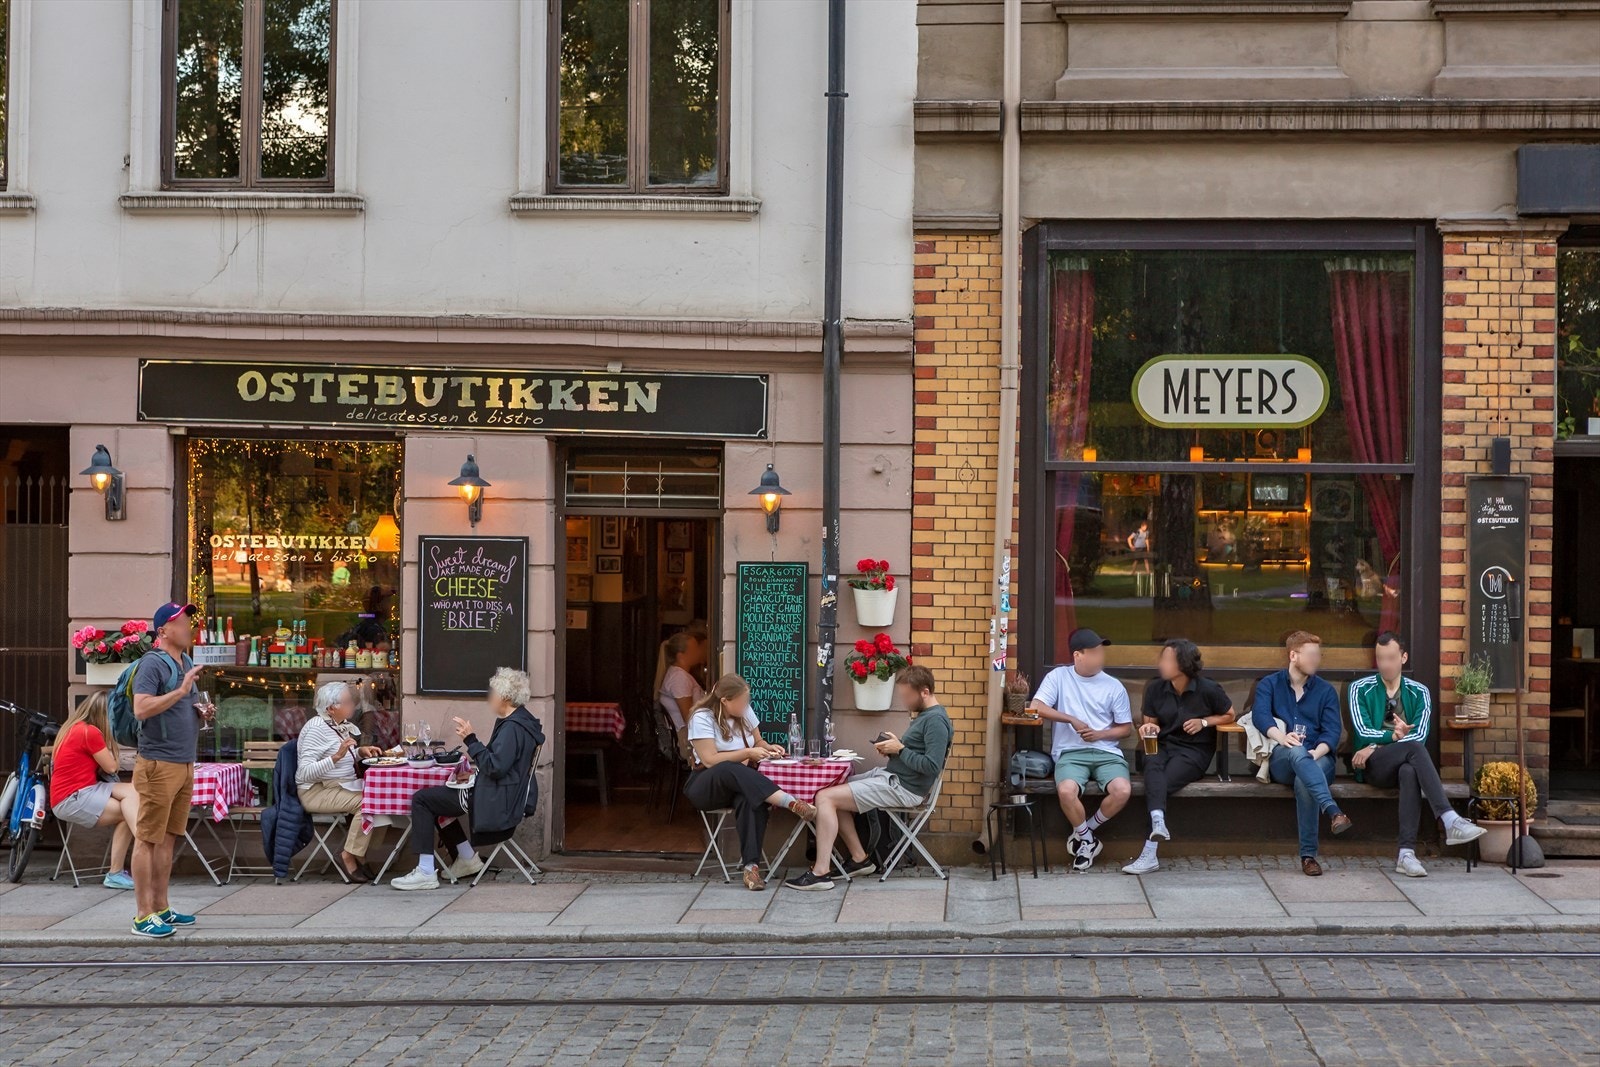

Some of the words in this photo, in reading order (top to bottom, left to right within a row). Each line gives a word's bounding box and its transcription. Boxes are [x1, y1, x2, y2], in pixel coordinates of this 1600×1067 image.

[236, 370, 661, 414] OSTEBUTIKKEN
[1163, 368, 1297, 415] MEYERS
[346, 407, 458, 423] delicatessen
[468, 410, 479, 423] &
[487, 410, 544, 425] bistro
[209, 534, 379, 550] OSTEBUTIKKEN
[212, 550, 307, 563] deliatessen
[313, 551, 323, 562] &
[330, 550, 378, 563] bistro
[428, 545, 467, 580] Sweet
[472, 546, 517, 583] dreams
[440, 566, 455, 576] ARE
[459, 565, 482, 575] MADE
[484, 568, 496, 578] OF
[743, 567, 802, 576] ESCARGOTS
[435, 577, 499, 599] CHEESE
[743, 583, 795, 592] RILLETTES
[743, 594, 803, 604] CHARCUTERIE
[452, 600, 464, 610] AM
[466, 600, 470, 609] I
[472, 600, 483, 609] TO
[486, 601, 503, 611] DISS
[506, 603, 513, 615] A
[778, 603, 803, 613] CHAUD
[448, 611, 497, 630] BRIE?
[743, 613, 775, 623] MOULES
[776, 613, 802, 624] FRITES
[742, 622, 800, 633] BOUILLABAISSE
[748, 633, 793, 643] BRANDADE
[742, 642, 800, 653] CASSOULET
[743, 652, 799, 662] PARMENTIER
[745, 678, 792, 689] FROMAGE
[749, 689, 799, 700] HAMPAGNE
[749, 700, 769, 711] ONS
[772, 700, 795, 712] VINS
